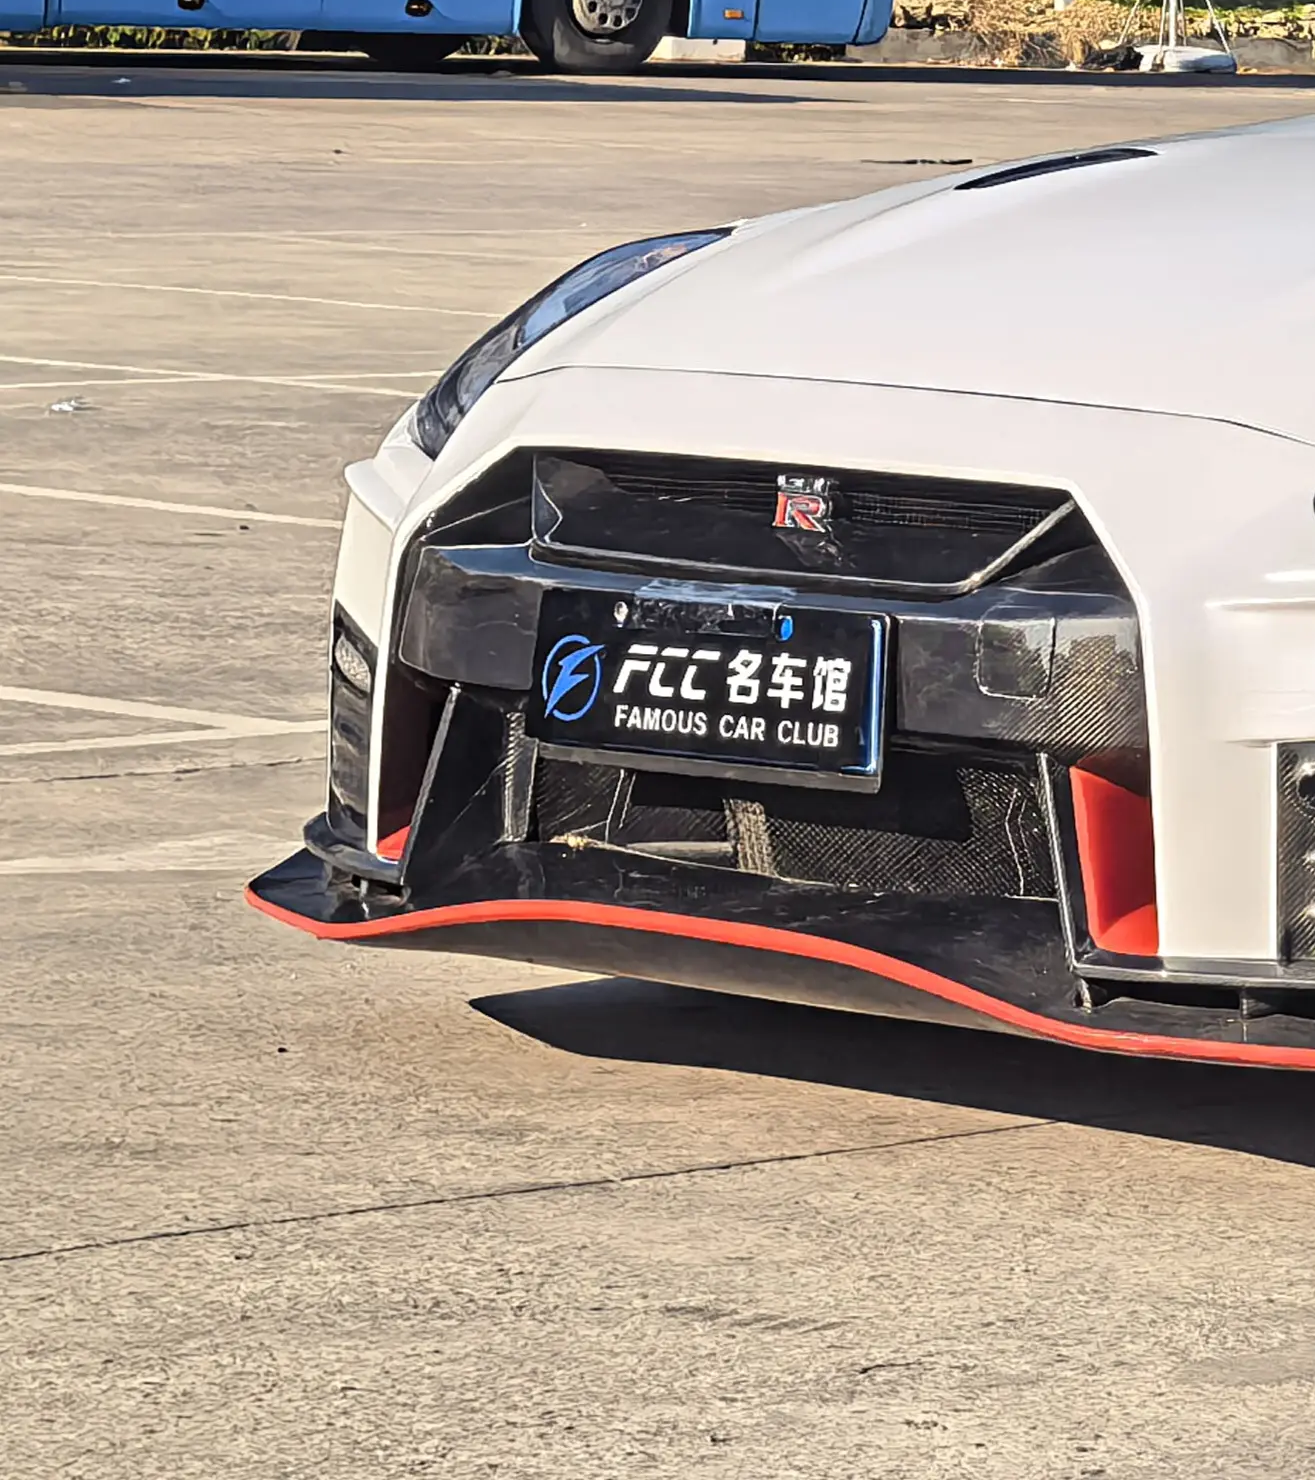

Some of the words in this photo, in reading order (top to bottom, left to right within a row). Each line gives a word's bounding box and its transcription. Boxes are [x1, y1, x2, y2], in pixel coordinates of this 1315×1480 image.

[612, 643, 721, 701] FCC
[726, 649, 852, 712] 名车馆
[614, 704, 708, 736] FAMOUS
[719, 714, 766, 742] CAR
[777, 720, 839, 748] CLUB
